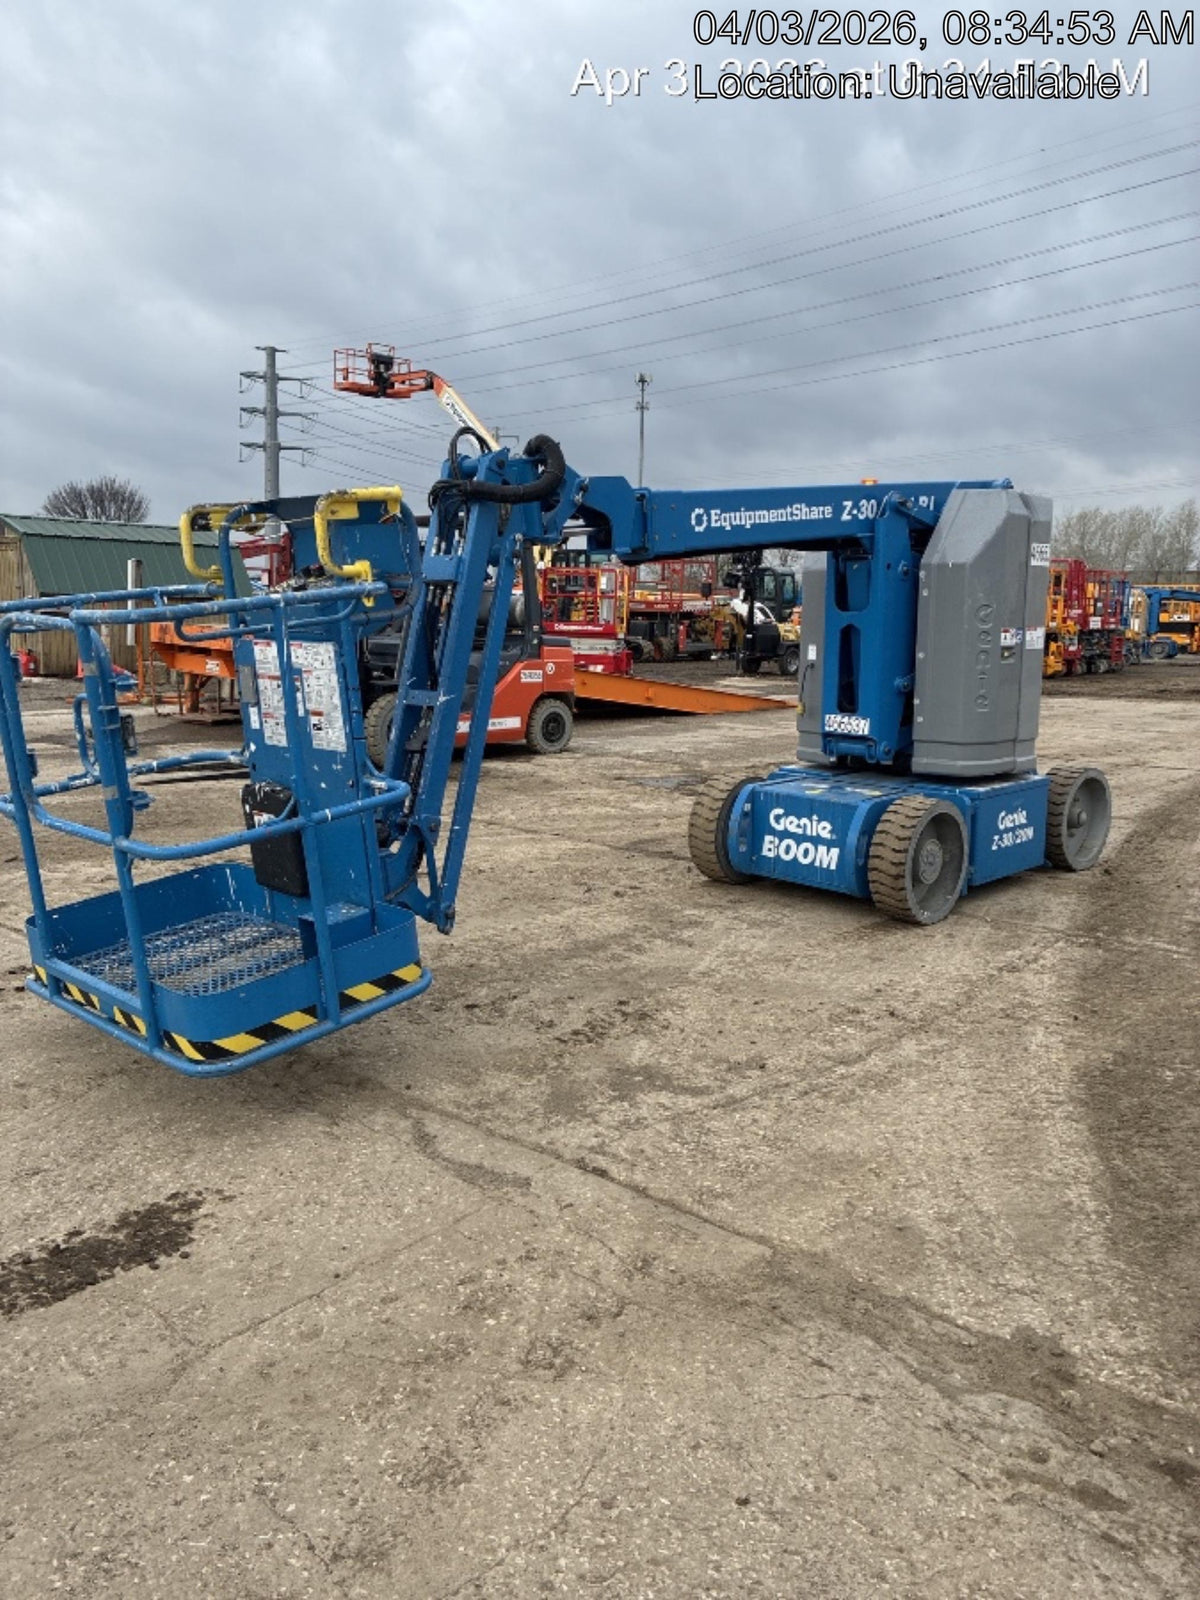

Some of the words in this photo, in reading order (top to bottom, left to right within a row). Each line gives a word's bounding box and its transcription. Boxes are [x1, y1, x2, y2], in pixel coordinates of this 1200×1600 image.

[710, 503, 834, 531] EquipmentShare
[769, 807, 833, 840] Genie
[997, 807, 1027, 831] Genie
[761, 835, 840, 870] BOOM
